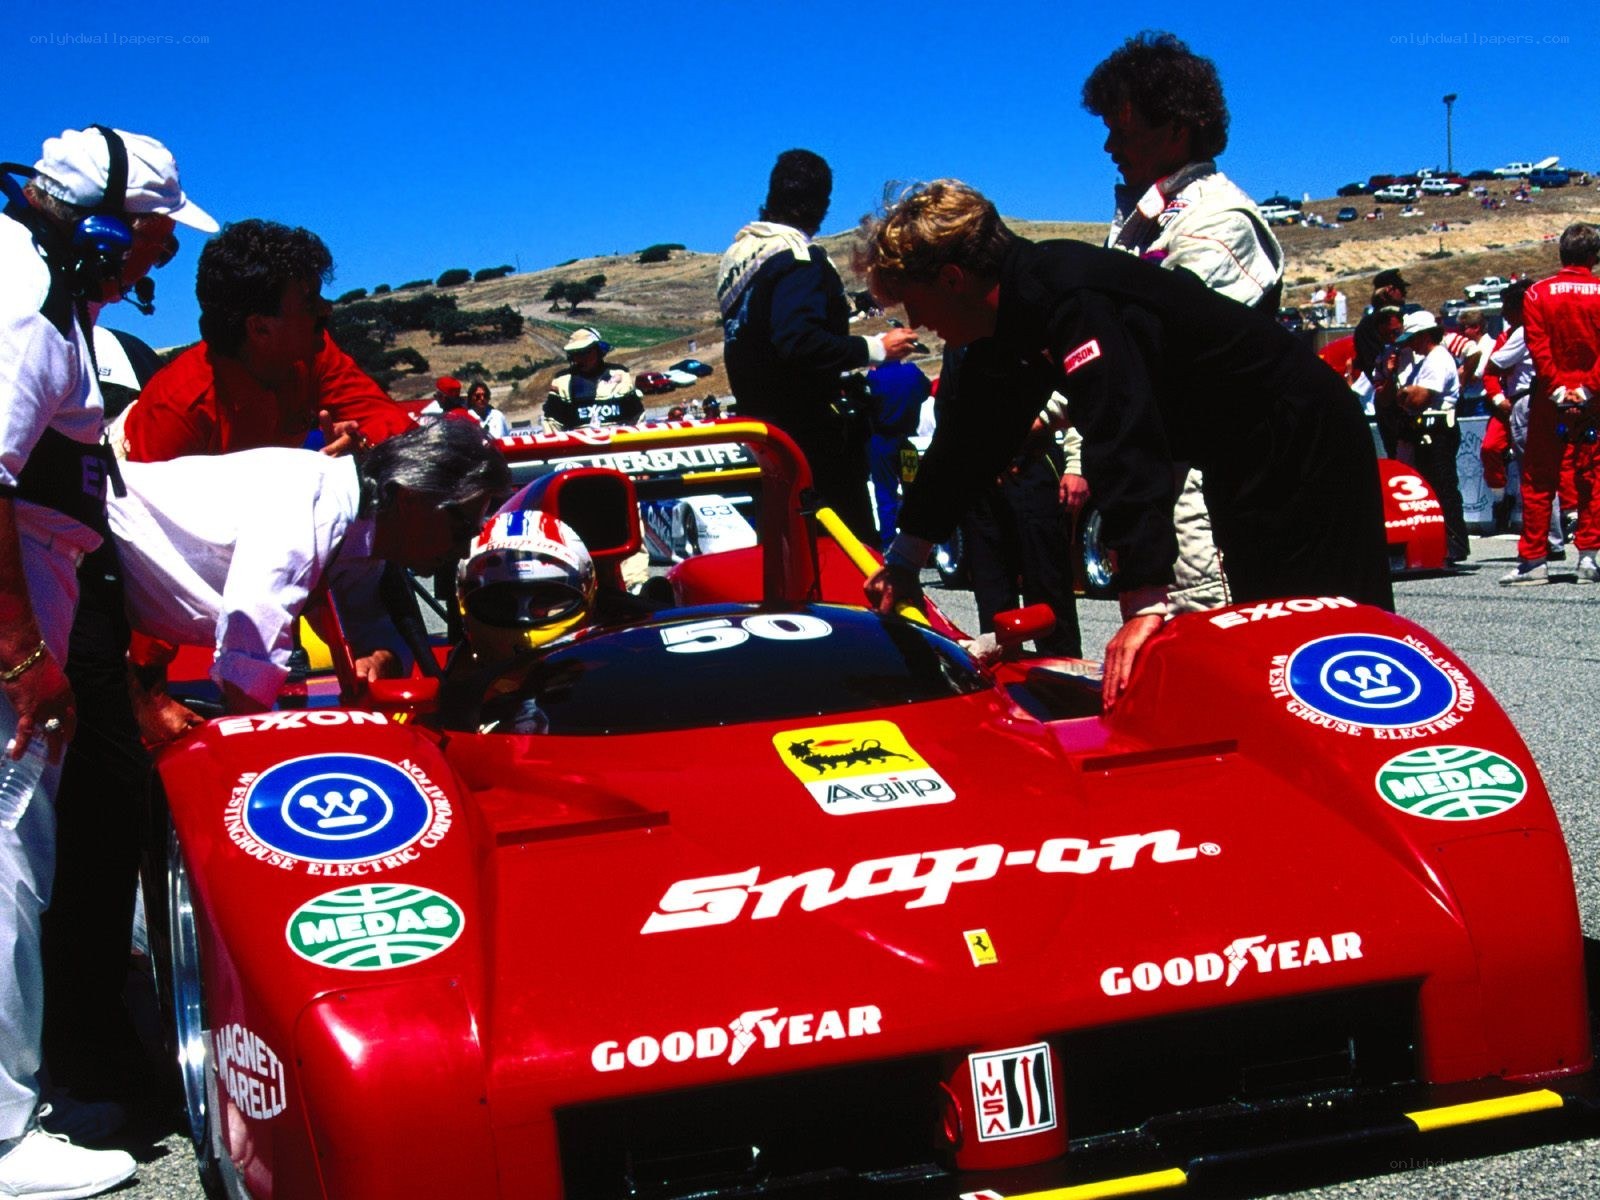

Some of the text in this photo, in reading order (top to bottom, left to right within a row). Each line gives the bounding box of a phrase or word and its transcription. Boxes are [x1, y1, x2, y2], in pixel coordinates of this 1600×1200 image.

[578, 404, 620, 421] EXXON
[591, 444, 747, 473] HERBALIFE
[1388, 475, 1429, 500] 3
[700, 505, 733, 517] 63
[1209, 596, 1357, 629] EXXON
[660, 614, 832, 653] 50
[218, 710, 388, 736] EXXON
[1373, 711, 1464, 740] ELECTRIC
[827, 777, 942, 803] Agip
[1386, 764, 1517, 800] MEDAS
[223, 758, 453, 877] WESTINGHOUSE ELECTRIC CORPORATION
[640, 828, 1199, 934] Snap-on
[298, 905, 453, 945] MEDAS
[980, 1062, 1005, 1134] IMSA
